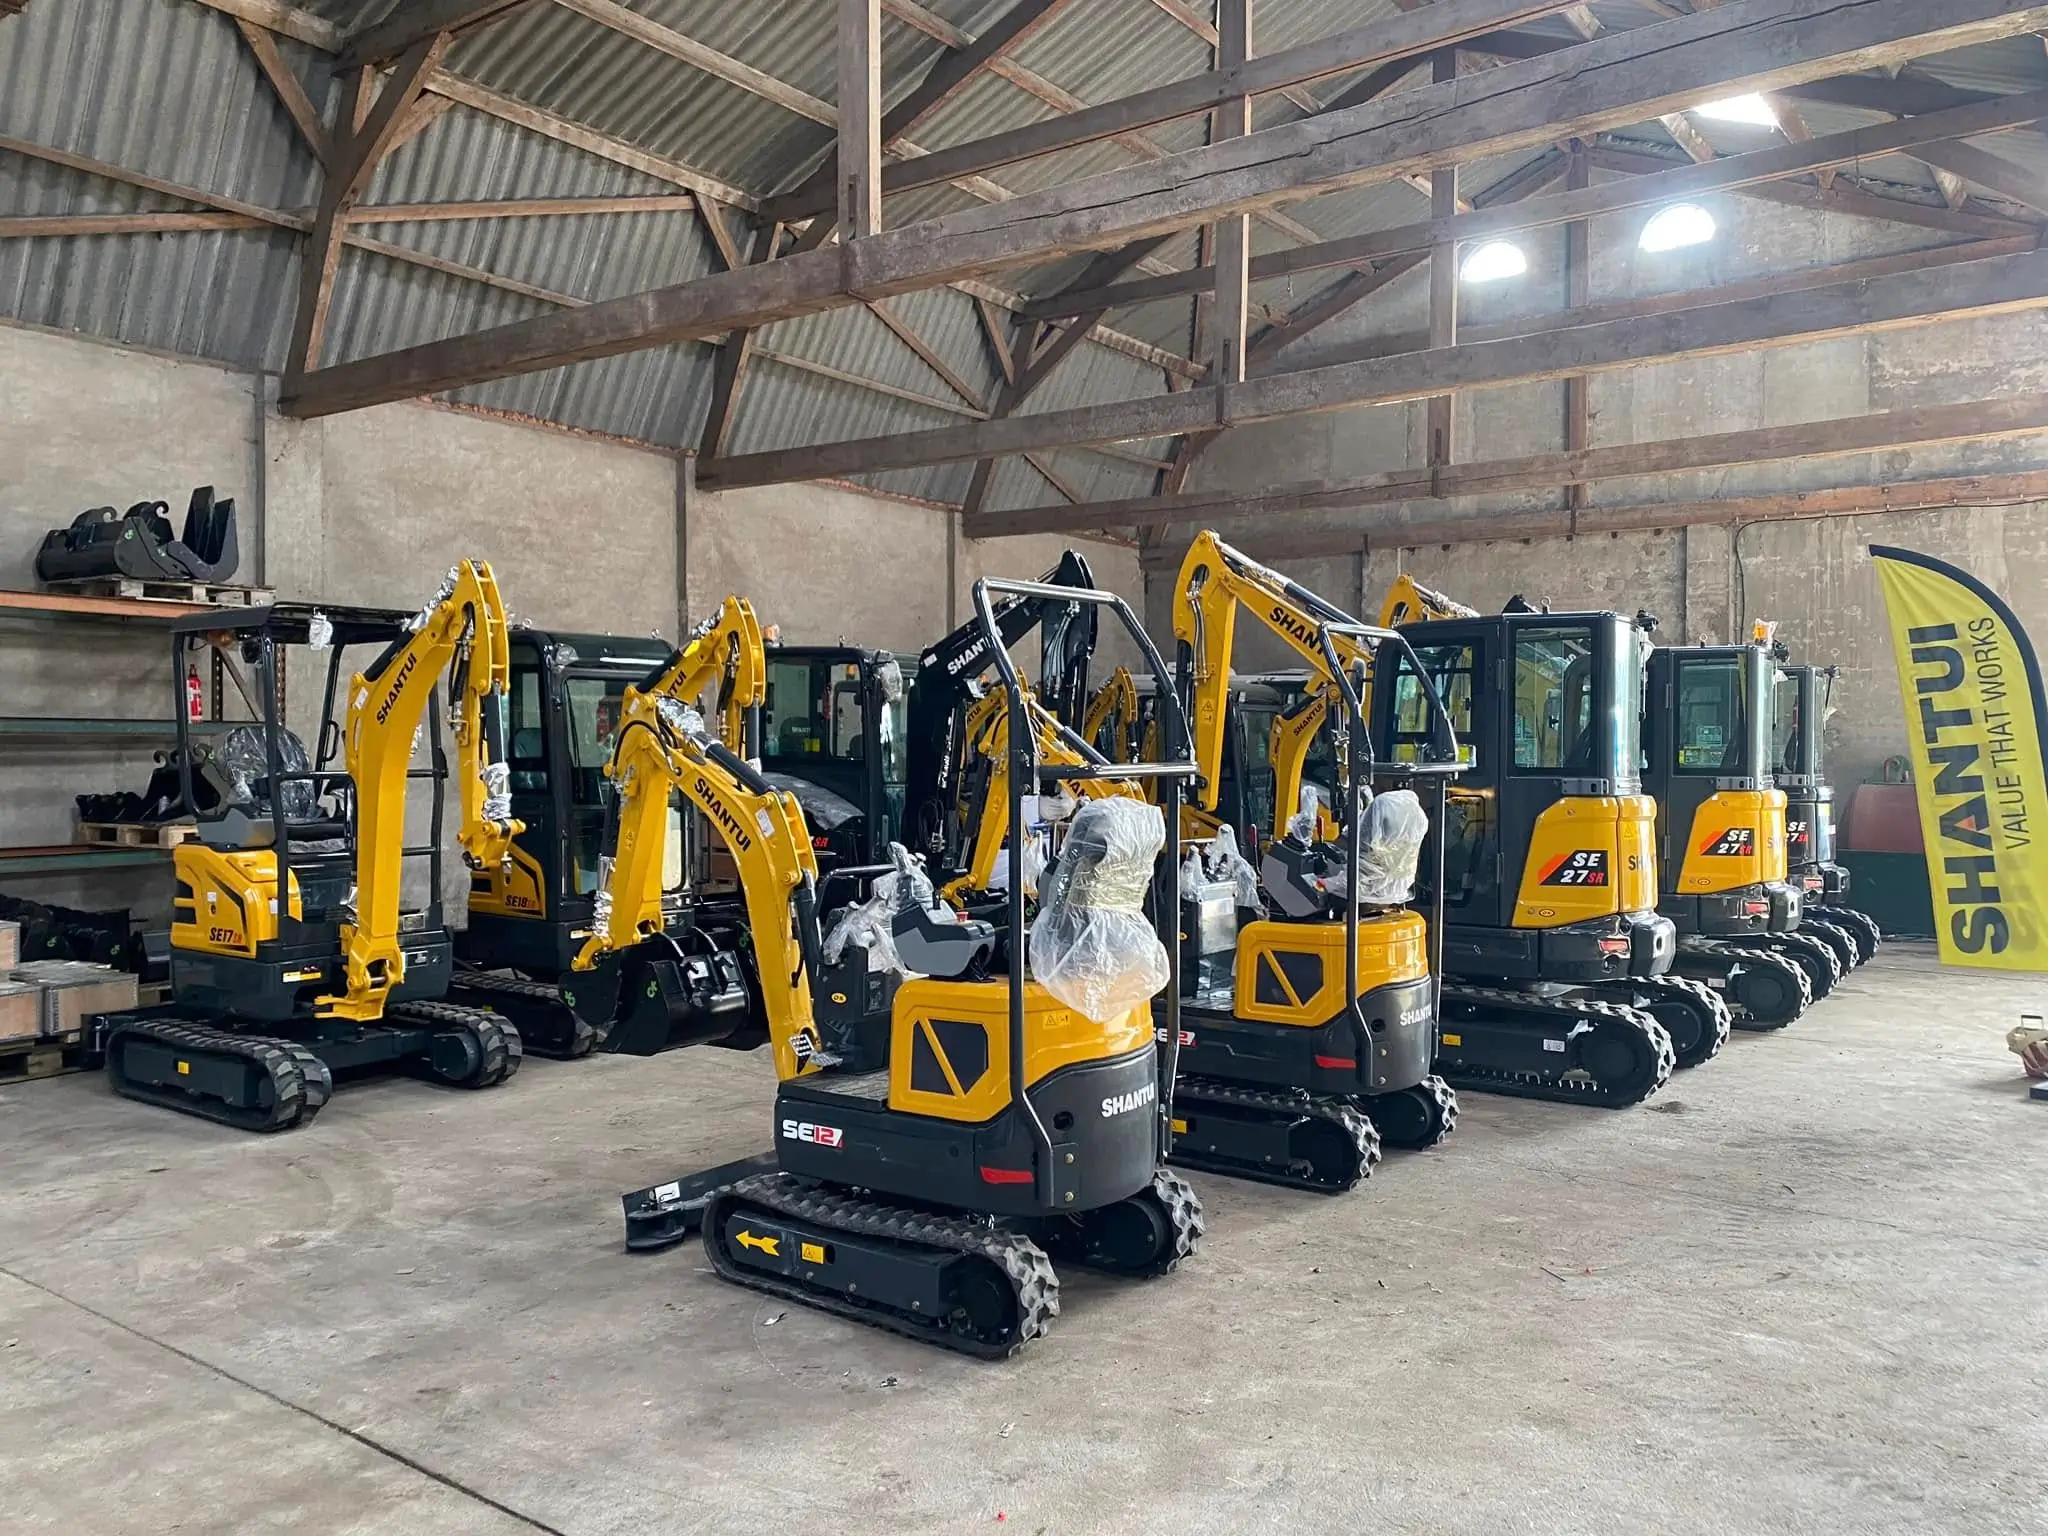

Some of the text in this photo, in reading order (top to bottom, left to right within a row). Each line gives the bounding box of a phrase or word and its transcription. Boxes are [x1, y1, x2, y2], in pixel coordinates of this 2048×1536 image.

[376, 652, 418, 725] SHANTUI
[1293, 703, 1324, 737] SHANTUI
[1968, 616, 2031, 851] VALUE THAT WORKS
[1908, 622, 2009, 956] SHANTUI
[694, 777, 752, 852] SHANTUI
[1788, 821, 1808, 832] SE
[1727, 829, 1750, 842] SE
[1560, 869, 1605, 884] 27SR
[1572, 852, 1602, 867] SE
[1101, 1082, 1155, 1118] SHANTU
[782, 1118, 838, 1147] SE12
